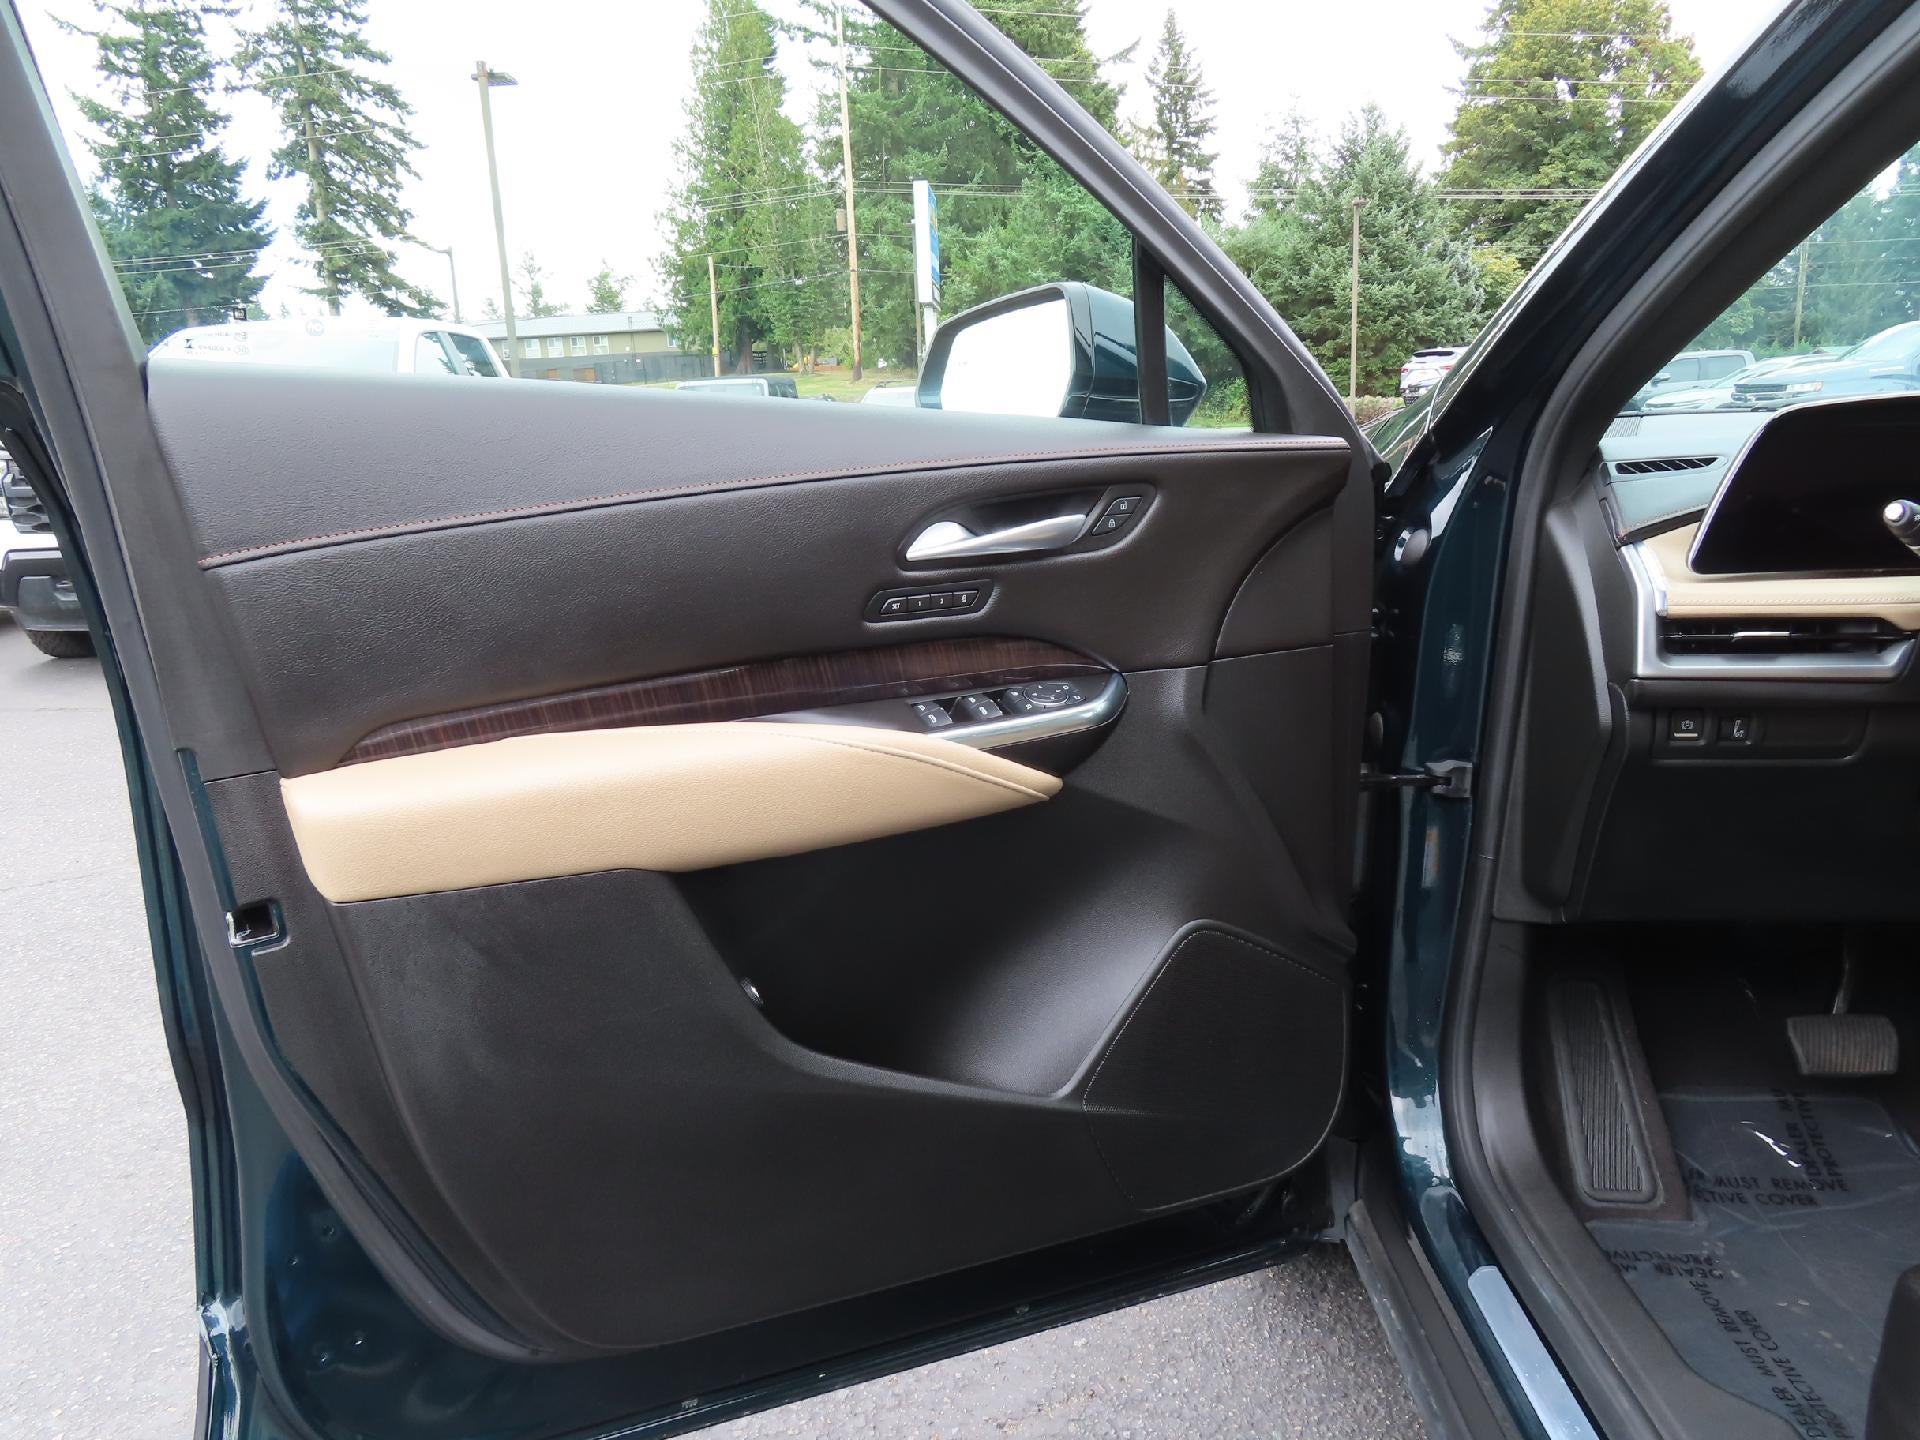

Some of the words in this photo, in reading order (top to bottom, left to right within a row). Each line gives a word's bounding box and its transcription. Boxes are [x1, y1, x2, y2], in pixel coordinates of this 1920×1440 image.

[1755, 1194, 1818, 1206] COVER
[1734, 1310, 1779, 1351] COVER
[1733, 1340, 1777, 1378] MUST
